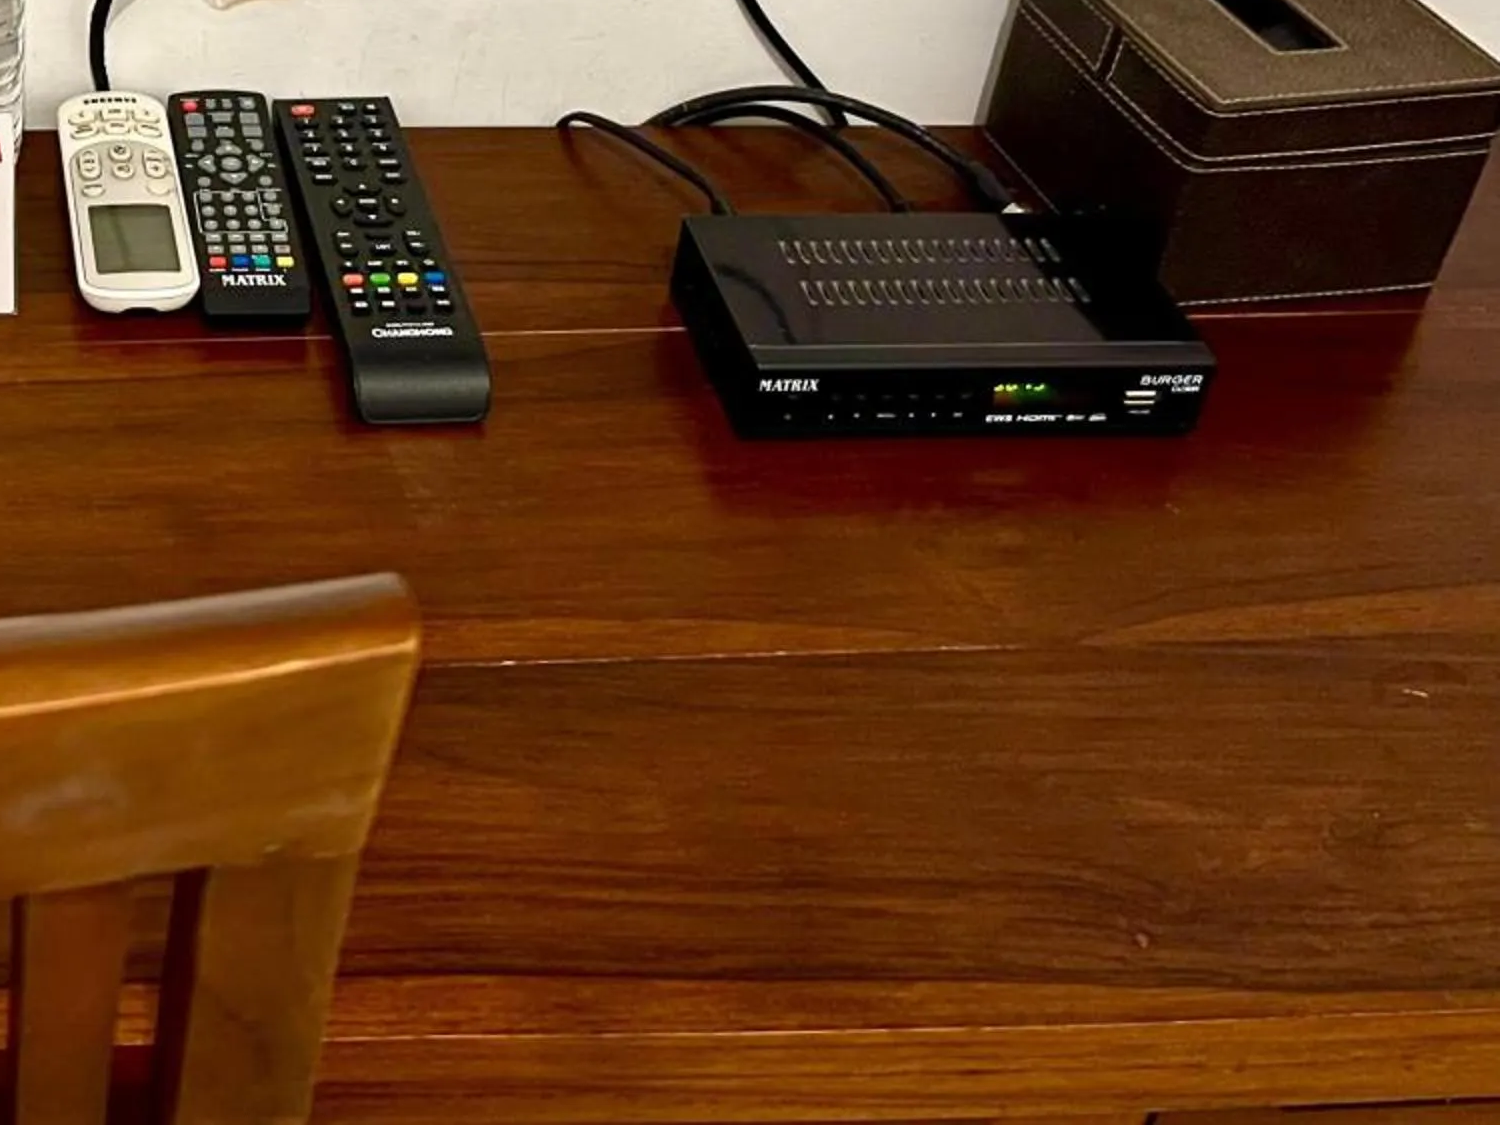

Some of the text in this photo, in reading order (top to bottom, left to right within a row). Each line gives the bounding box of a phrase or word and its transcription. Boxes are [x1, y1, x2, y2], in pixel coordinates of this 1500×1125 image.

[221, 274, 288, 287] MATRIX
[759, 378, 820, 392] MATRIX
[1139, 374, 1204, 386] BURGER
